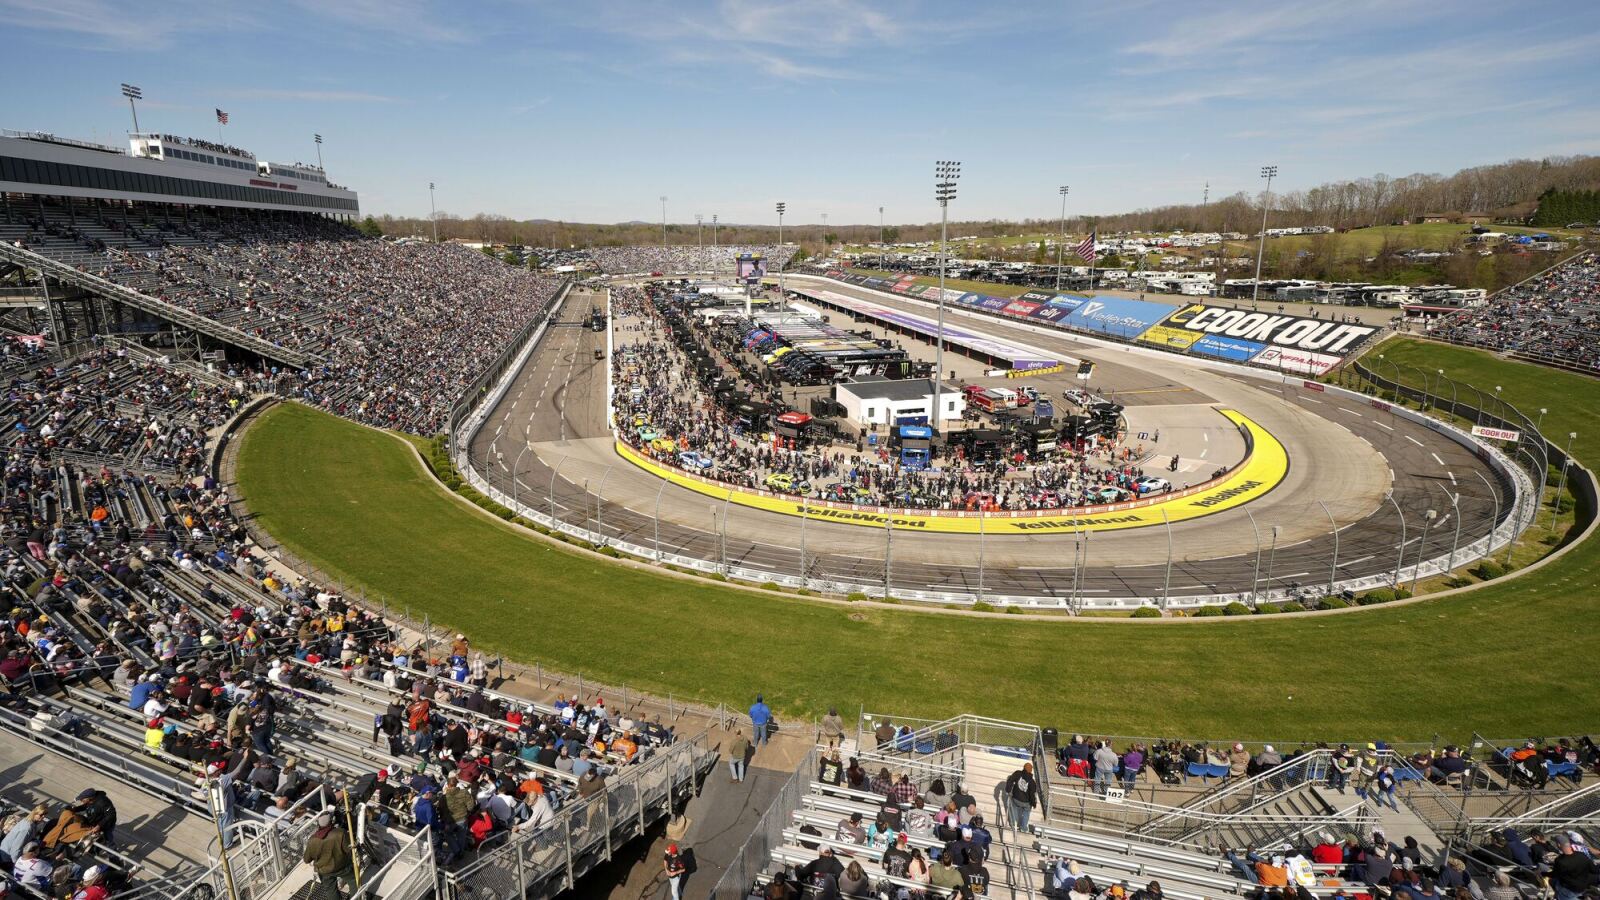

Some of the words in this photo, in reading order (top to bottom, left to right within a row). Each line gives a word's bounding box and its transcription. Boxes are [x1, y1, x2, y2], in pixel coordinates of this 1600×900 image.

[1185, 307, 1295, 341] COOK
[1273, 319, 1377, 353] OUT
[1480, 428, 1500, 438] COOK
[1500, 431, 1515, 439] OUT
[1189, 480, 1263, 508] YellaWood
[797, 505, 926, 528] YellaWood
[1010, 514, 1144, 530] YellaWood
[1108, 791, 1122, 799] 102
